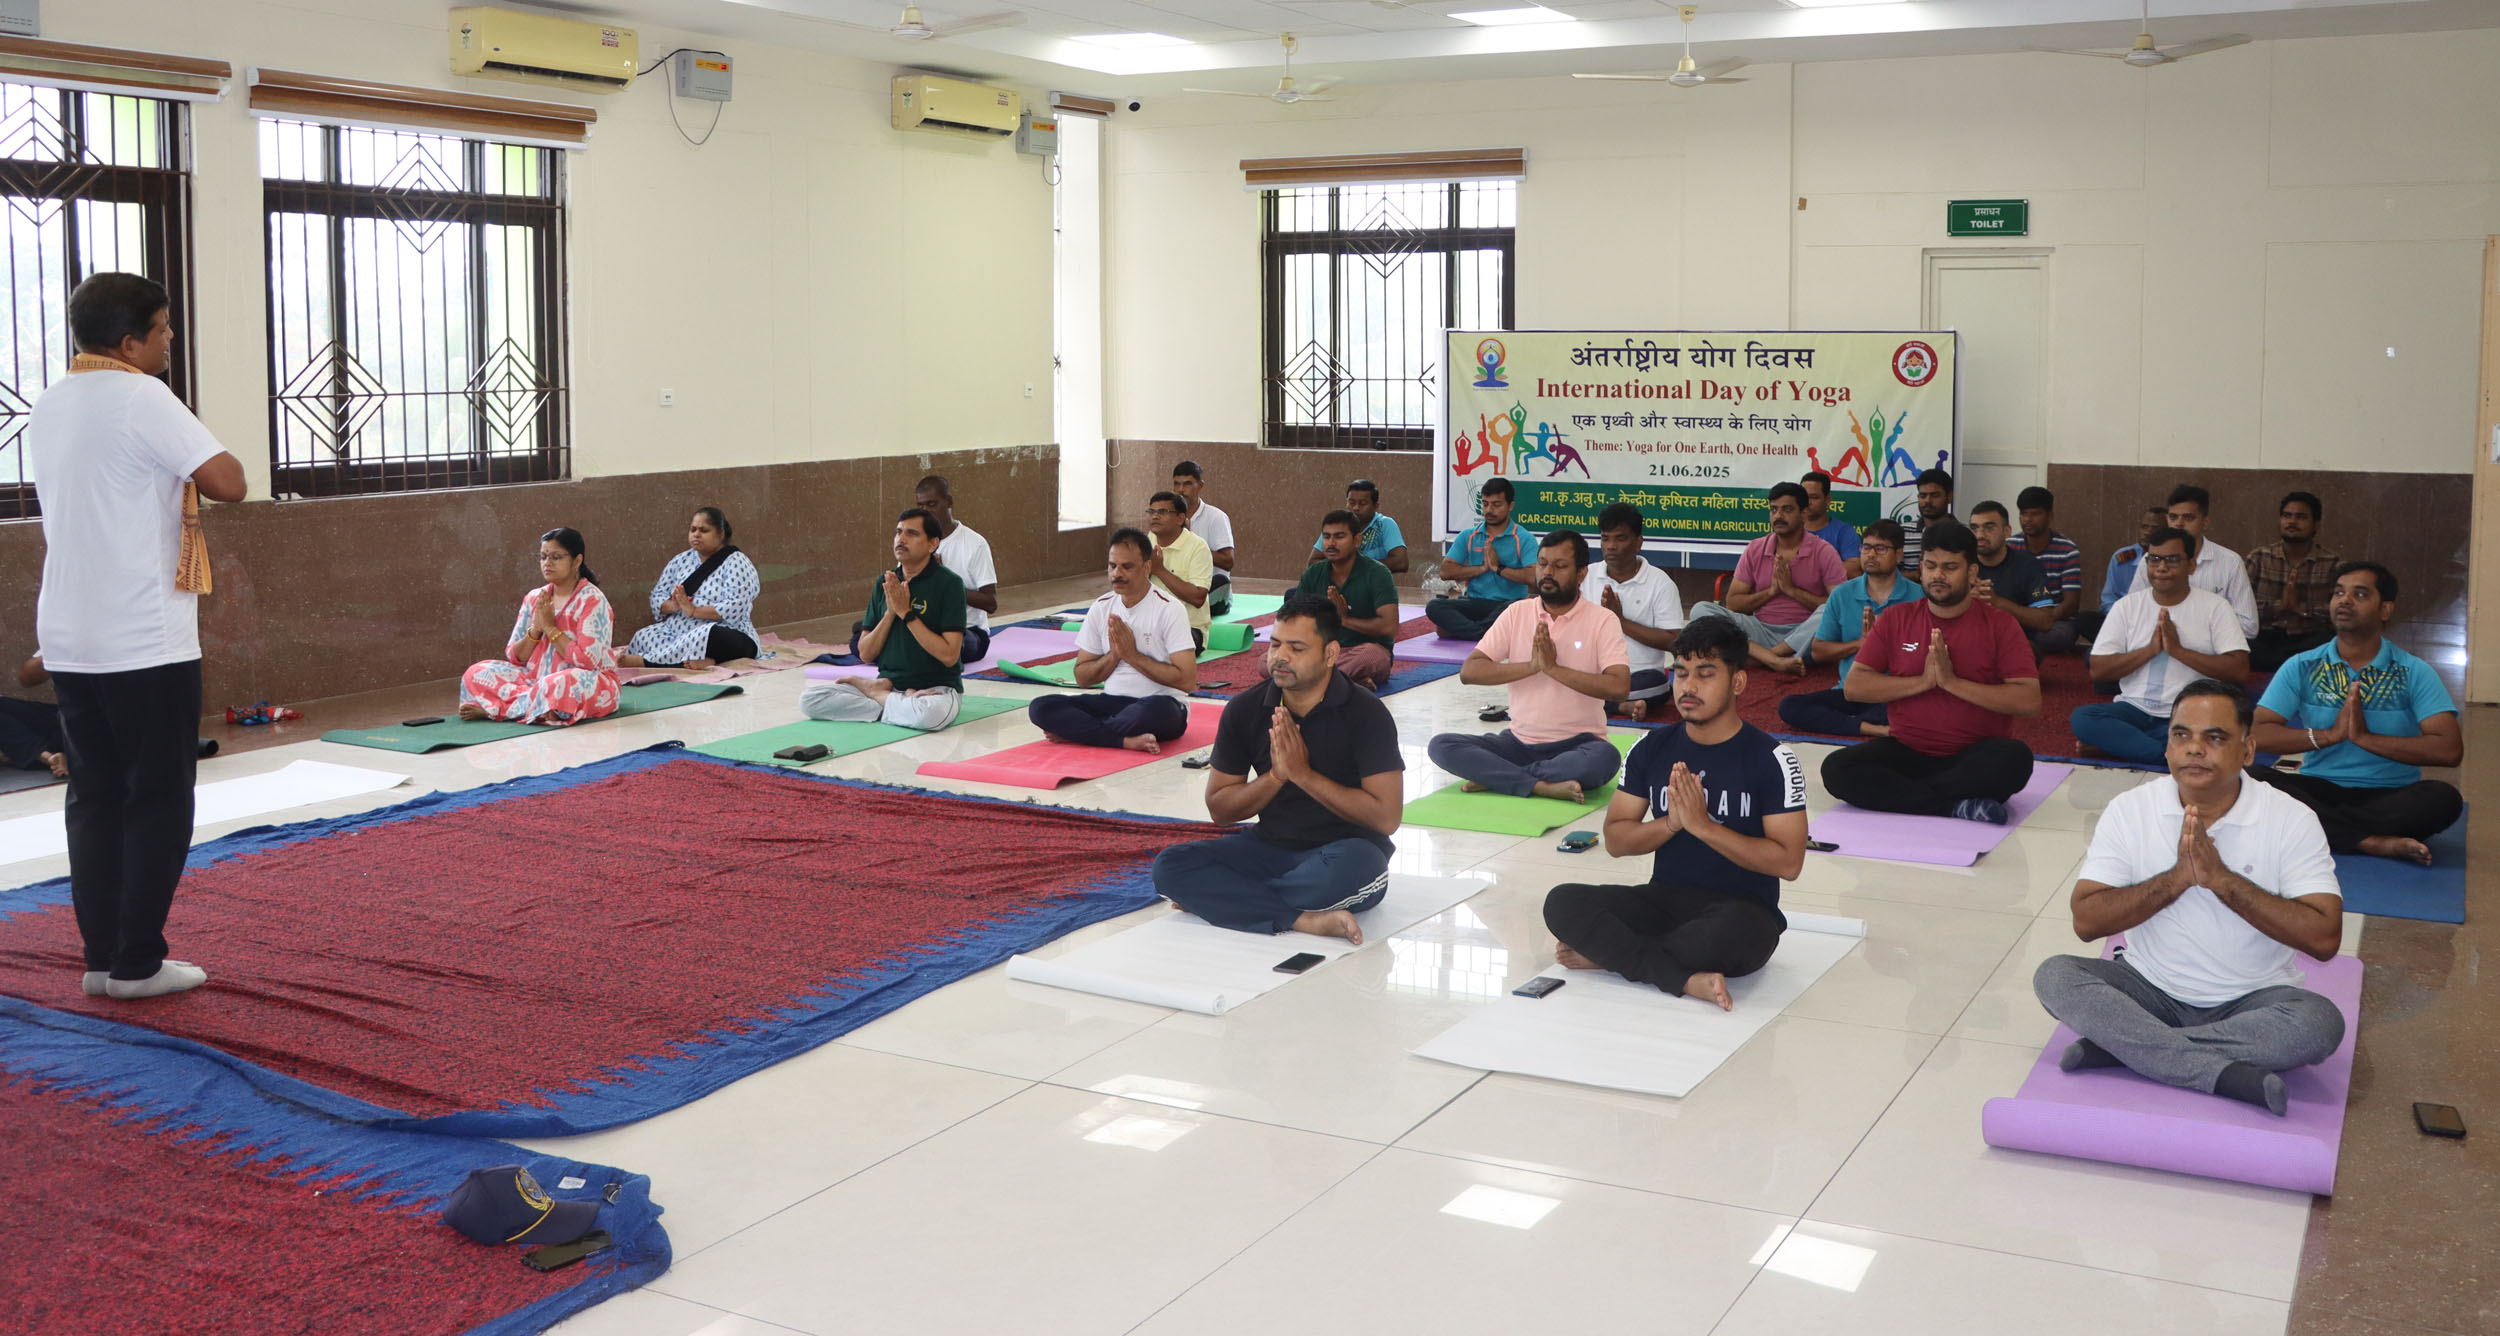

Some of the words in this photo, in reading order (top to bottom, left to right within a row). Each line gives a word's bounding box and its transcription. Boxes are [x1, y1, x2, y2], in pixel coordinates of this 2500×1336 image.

[1974, 207, 2001, 216] प्रसाधन
[1970, 220, 2004, 228] TOILET
[1570, 338, 1681, 373] अंतर्राष्ट्रीय
[1688, 339, 1736, 368] योग
[1744, 340, 1815, 370] दिवस
[1537, 378, 1692, 400] International
[1701, 379, 1747, 406] Day
[1755, 380, 1782, 401] of
[1787, 380, 1852, 407] Yoga
[1572, 415, 1596, 430] एक
[1601, 411, 1634, 431] पृथ्वी
[1639, 410, 1668, 428] और
[1672, 416, 1723, 429] स्वास्थ्य
[1728, 413, 1744, 430] के
[1748, 414, 1780, 435] लिए
[1783, 414, 1813, 431] योग
[1584, 439, 1623, 452] Theme:
[1626, 440, 1653, 454] Yoga
[1656, 441, 1672, 453] for
[1674, 441, 1697, 453] One
[1700, 442, 1734, 456] Earth,
[1736, 443, 1759, 455] One
[1762, 443, 1798, 456] Health
[1649, 464, 1730, 478] 21.06.2025
[1619, 489, 1656, 507] केन्द्रीय
[1659, 491, 1699, 511] कृषिरत
[1701, 492, 1739, 510] महिला
[1518, 513, 1587, 526] ICAR-CENTRAL
[1662, 518, 1700, 530] WOMEN
[1702, 520, 1712, 530] IN
